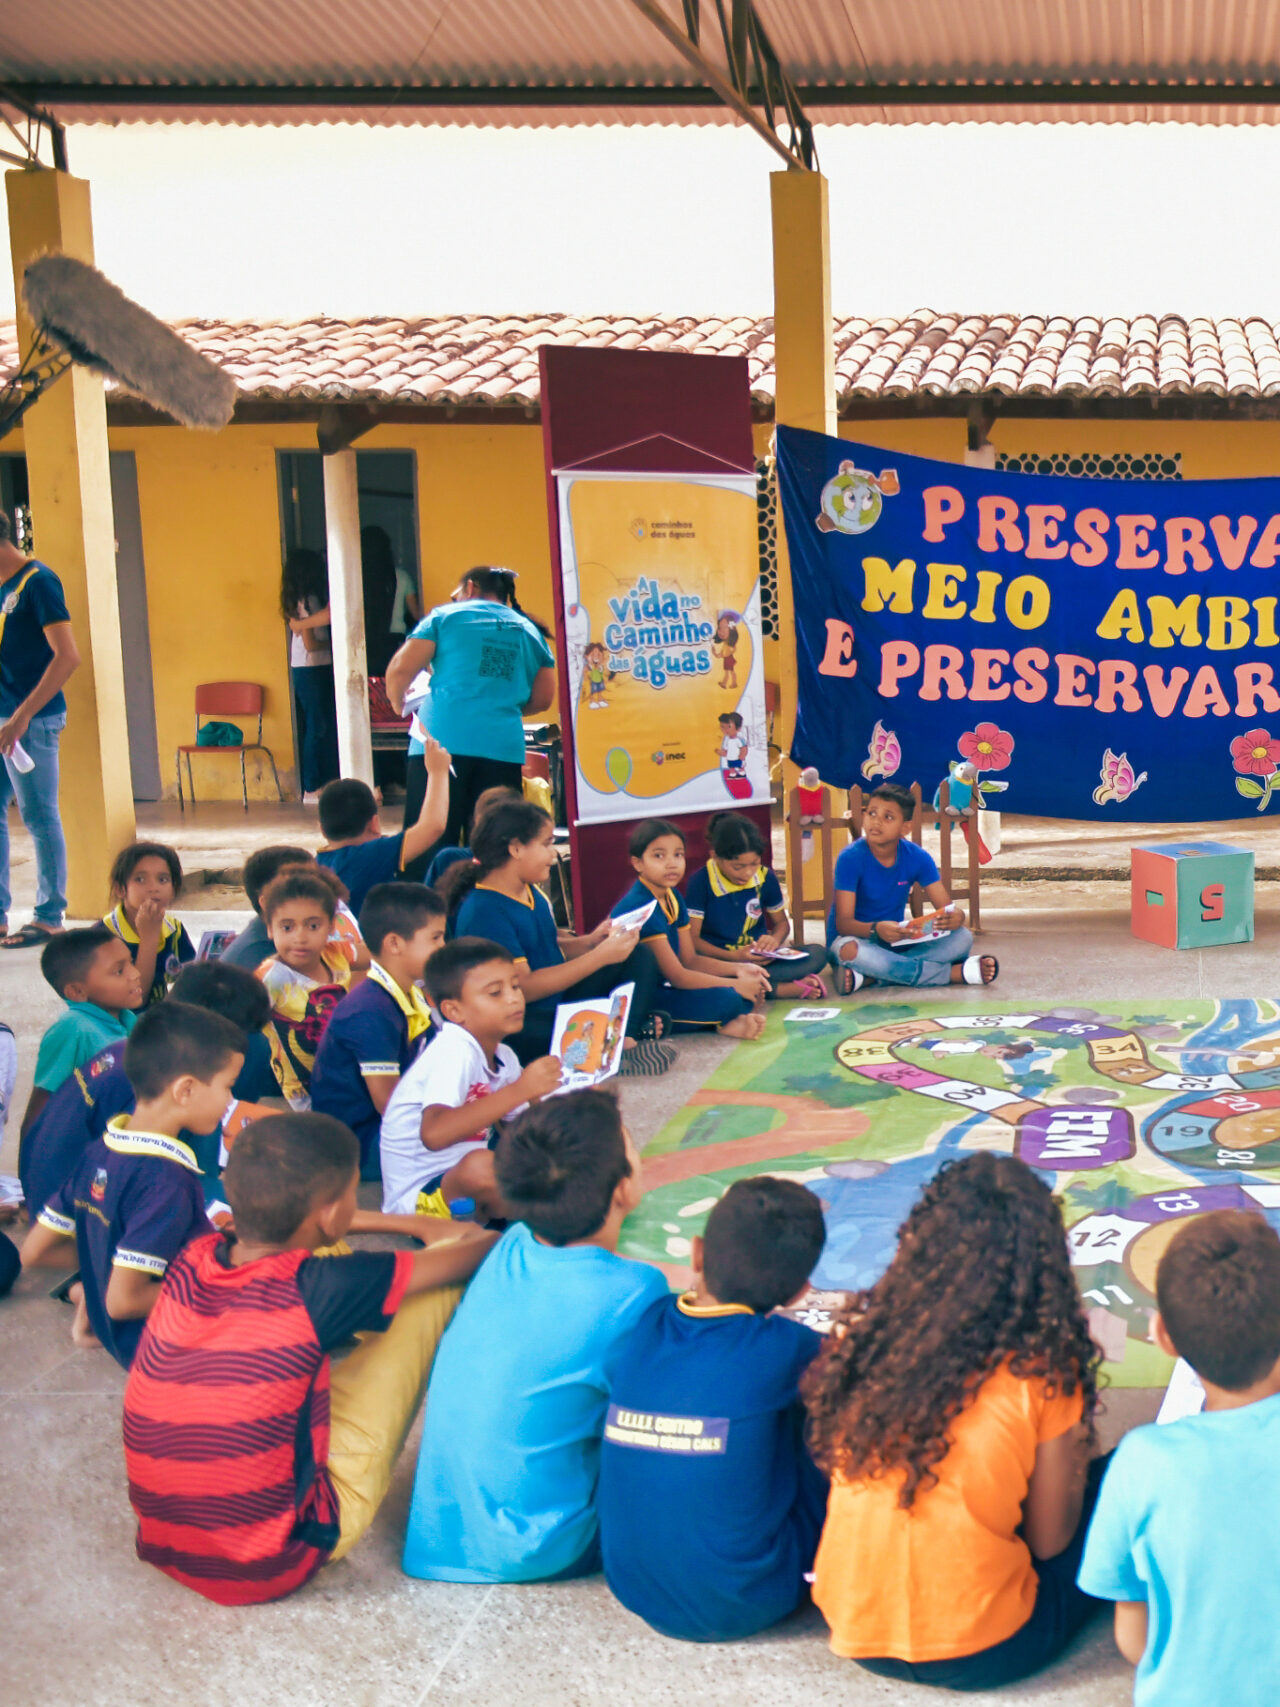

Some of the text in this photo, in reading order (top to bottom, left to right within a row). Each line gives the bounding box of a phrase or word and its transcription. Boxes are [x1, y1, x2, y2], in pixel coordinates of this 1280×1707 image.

[680, 595, 701, 610] no
[861, 557, 1051, 630] MEIO
[605, 612, 714, 651] Caminho
[818, 618, 858, 678] E
[608, 646, 712, 690] das águas
[842, 1046, 887, 1058] 38
[1096, 1042, 1139, 1055] 34
[877, 1067, 922, 1082] 39
[943, 1085, 988, 1101] 40
[1213, 1095, 1262, 1112] 20
[1158, 1125, 1205, 1137] 19
[1216, 1148, 1257, 1167] 18
[1152, 1192, 1200, 1212] 13
[1074, 1228, 1122, 1248] 12
